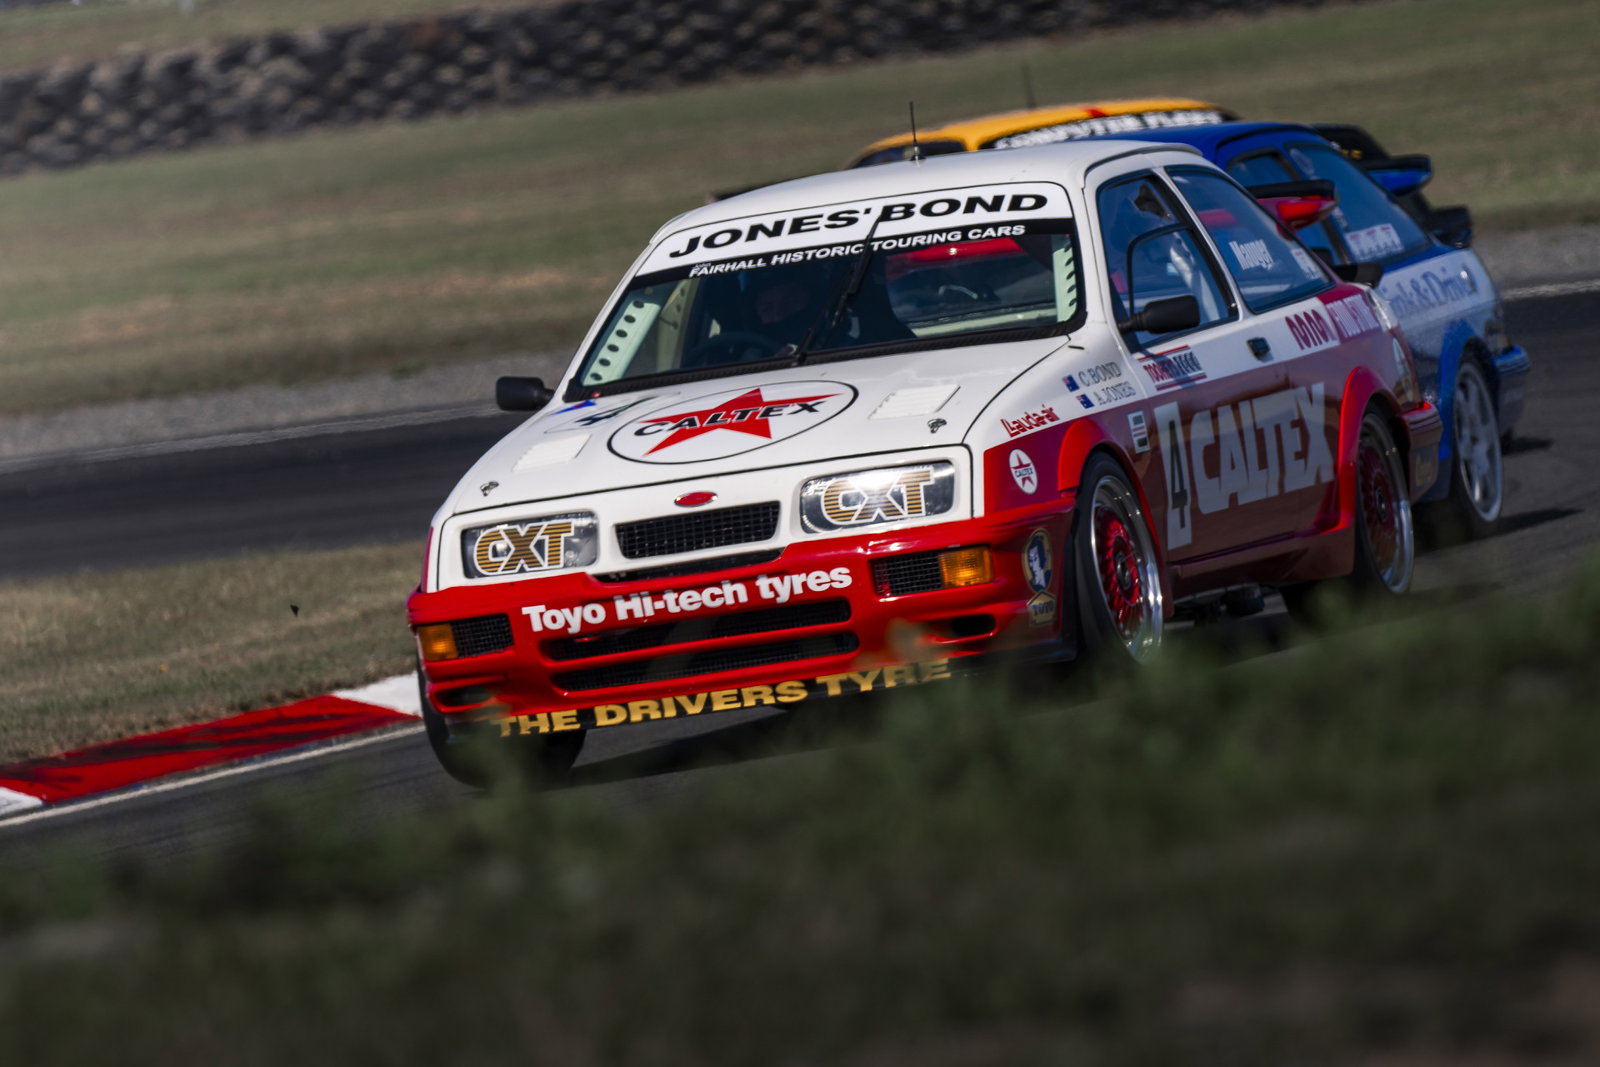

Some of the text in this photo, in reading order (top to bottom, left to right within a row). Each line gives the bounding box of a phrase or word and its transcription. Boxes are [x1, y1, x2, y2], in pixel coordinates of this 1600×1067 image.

[879, 194, 1048, 223] BOND
[688, 224, 1026, 278] FAIRHALL HISTORIC TOURING CARS
[633, 401, 825, 436] CALTEX
[1190, 382, 1335, 515] CALTEX
[820, 465, 935, 526] CXT
[1168, 420, 1189, 529] 4
[473, 520, 575, 576] CXT
[521, 566, 853, 634] Toyo Hi-tech tyres
[490, 658, 952, 737] THE DRIVERS TYRE
